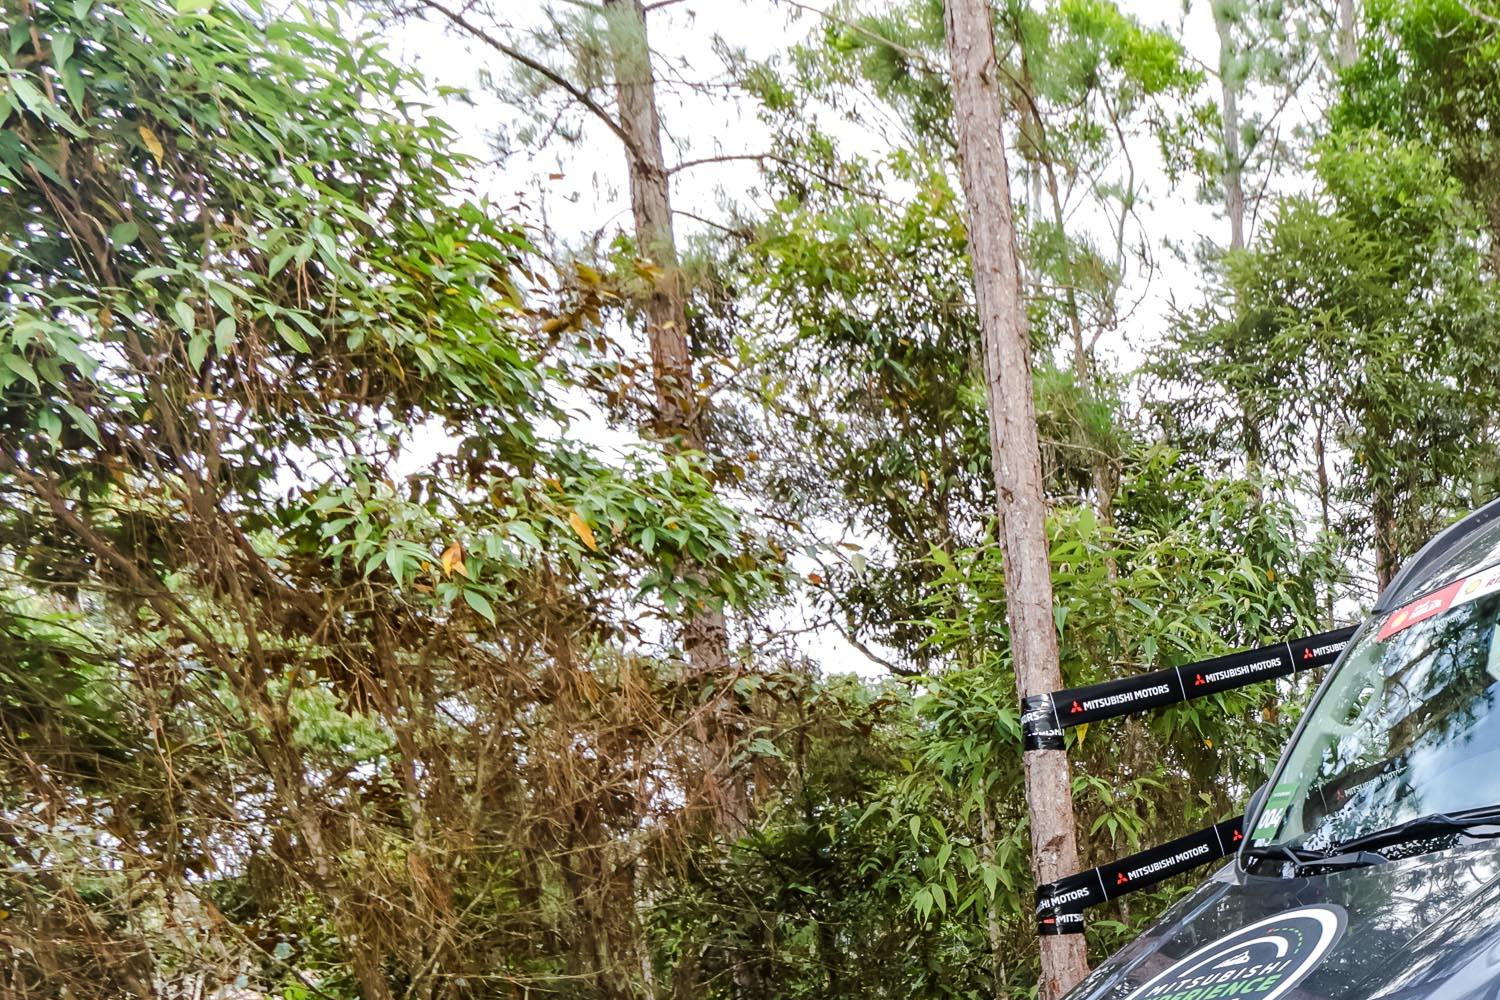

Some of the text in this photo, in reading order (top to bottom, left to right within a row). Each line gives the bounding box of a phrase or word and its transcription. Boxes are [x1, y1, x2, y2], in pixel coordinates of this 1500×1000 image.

[1312, 640, 1350, 657] MITSUBIS
[1205, 657, 1282, 683] MITSUBISHI MOTORS
[1082, 683, 1170, 712] MITSUBISHI MOTORS
[1259, 806, 1284, 830] 004
[1127, 843, 1210, 881] MITSUBISHI MOTORS
[1050, 886, 1090, 907] MOTORS
[1144, 959, 1292, 998] MITSUBISHI
